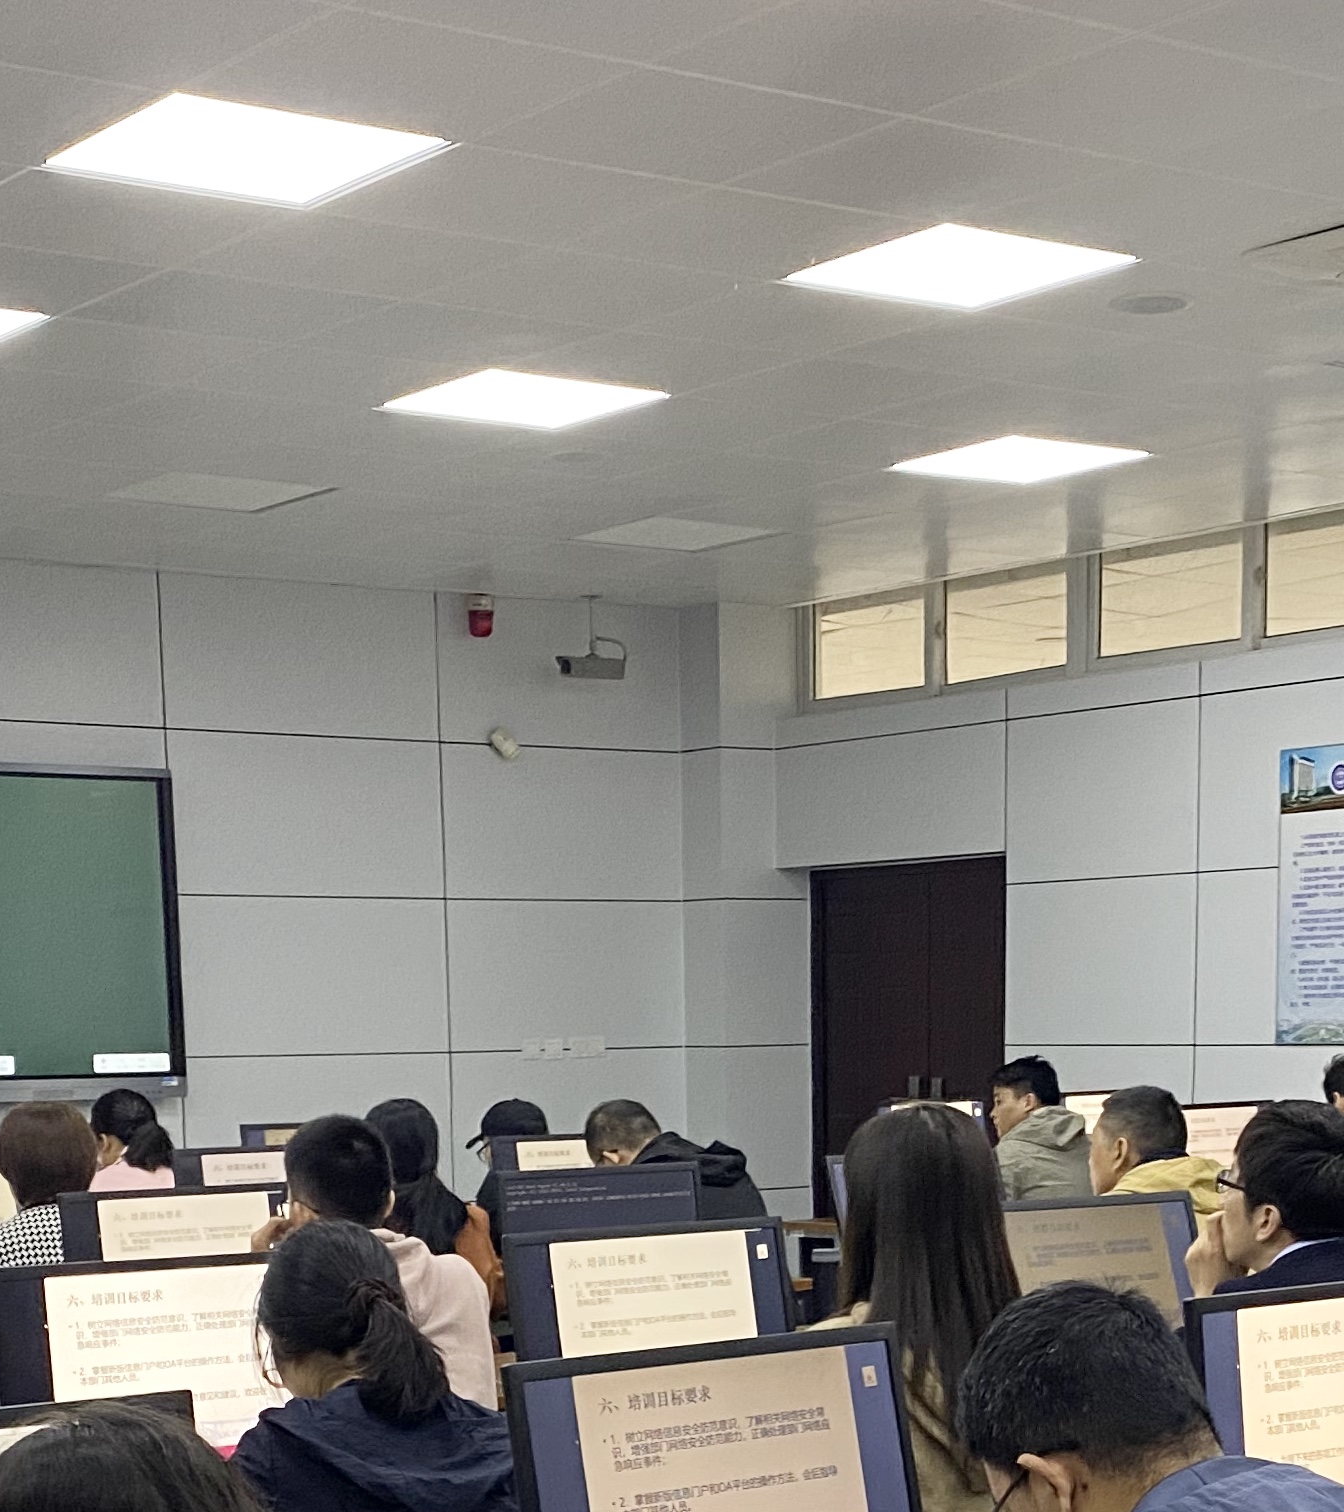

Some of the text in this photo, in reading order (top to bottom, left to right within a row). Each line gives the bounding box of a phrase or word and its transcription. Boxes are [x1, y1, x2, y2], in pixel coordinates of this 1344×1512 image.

[598, 1385, 712, 1415] 六、培训目标要求
